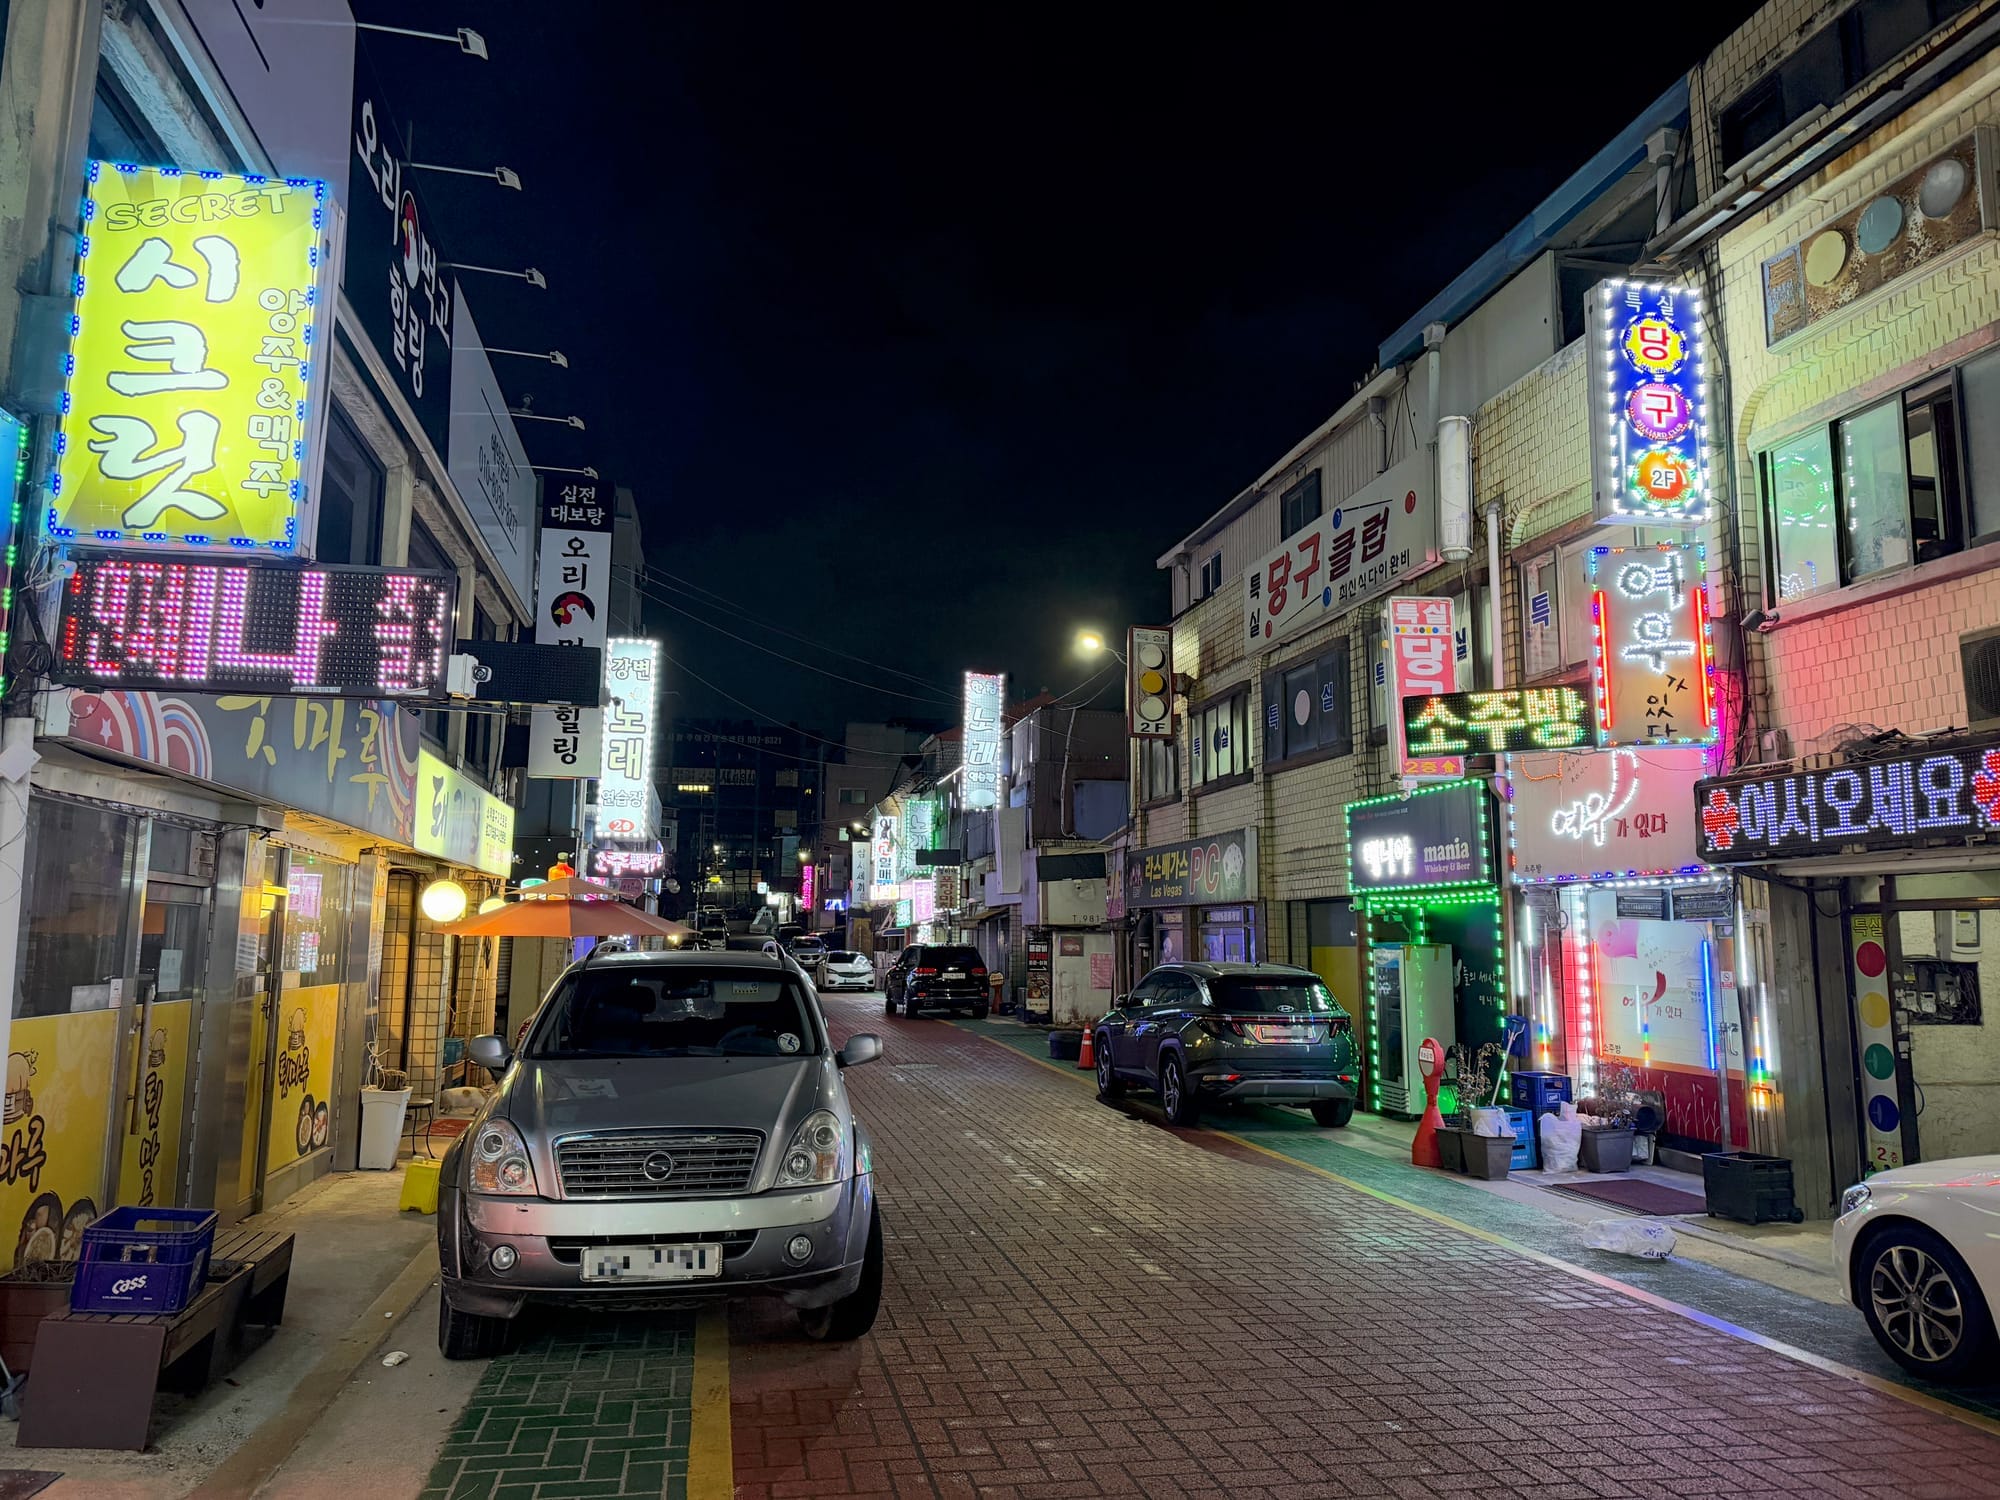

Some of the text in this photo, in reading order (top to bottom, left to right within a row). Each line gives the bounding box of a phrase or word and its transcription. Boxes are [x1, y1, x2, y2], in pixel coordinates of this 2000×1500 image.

[105, 186, 292, 232] SECRET
[356, 99, 450, 349] 오리 먹고
[389, 263, 426, 398] 힐링
[87, 235, 243, 530] 시크릿
[241, 288, 308, 499] 양주&맥주
[1651, 469, 1677, 489] 2F
[560, 485, 596, 505] 십전
[550, 505, 606, 526] 대보탕
[561, 536, 592, 591] 오리
[1267, 506, 1390, 617] 당구 클럽
[1395, 602, 1448, 625] 특실
[1531, 591, 1550, 629] 특
[1616, 551, 1697, 675] 여우
[611, 656, 651, 681] 강변
[1320, 681, 1334, 713] 실
[1140, 722, 1166, 733] 2F
[1268, 703, 1279, 730] 특
[1408, 687, 1586, 753] 소주방
[552, 706, 582, 766] 힐링
[607, 700, 647, 781] 노래
[1220, 725, 1229, 749] 실
[1404, 761, 1438, 774] 2층
[600, 788, 644, 808] 연습장
[1739, 755, 1972, 847] 어서오세요
[1615, 818, 1629, 838] 가
[1633, 812, 1669, 838] 있다
[1423, 837, 1470, 863] mania
[1189, 842, 1221, 896] PC
[1424, 863, 1450, 874] Whiskey
[1524, 864, 1542, 874] 소주방
[1150, 885, 1162, 898] Las
[1163, 884, 1183, 897] Vegas
[1603, 1043, 1621, 1055] 소주방
[111, 1275, 148, 1295] Cass
